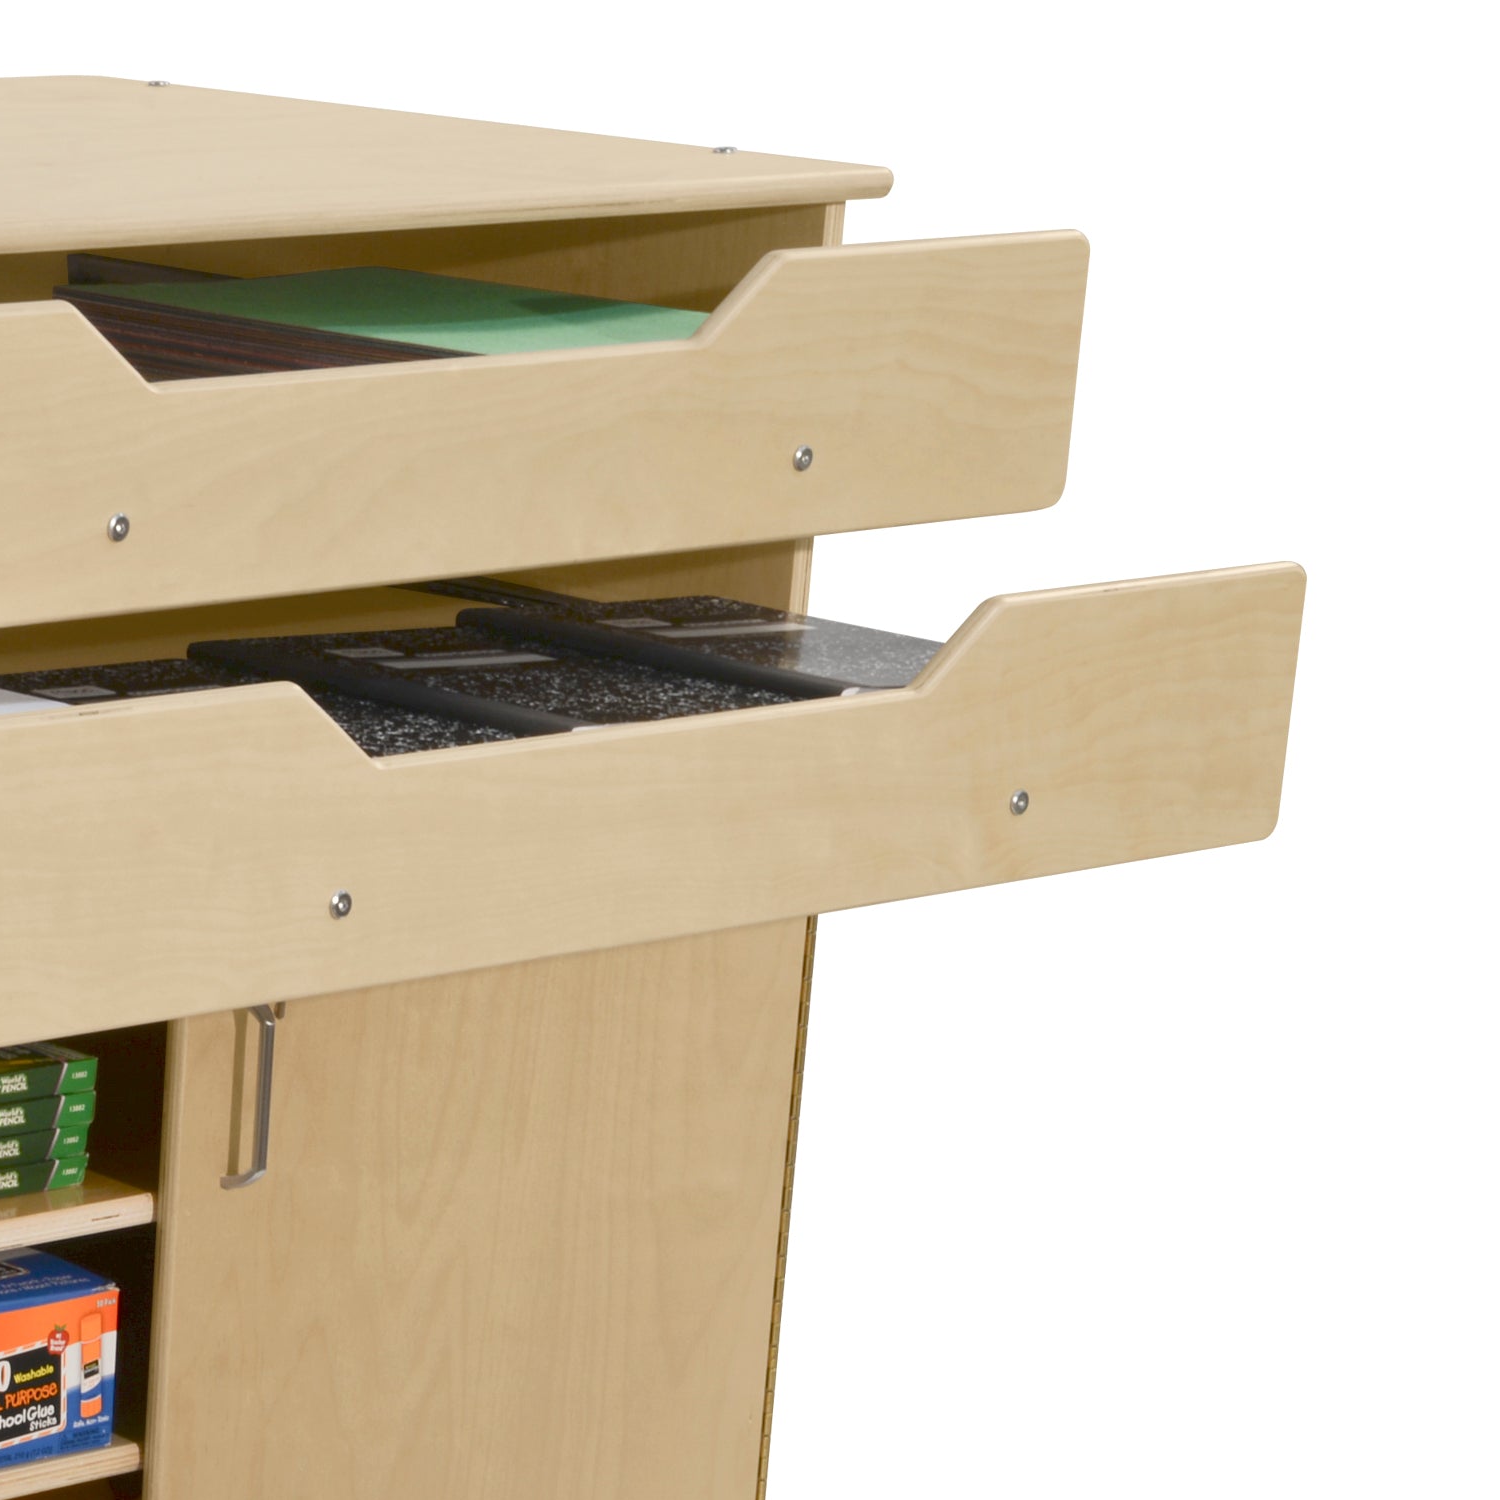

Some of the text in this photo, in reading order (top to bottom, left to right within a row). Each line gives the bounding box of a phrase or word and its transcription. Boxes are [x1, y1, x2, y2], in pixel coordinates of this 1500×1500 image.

[1, 1073, 27, 1084] World's
[1, 1082, 28, 1094] PENCIL
[0, 1116, 26, 1127] PENCIL
[13, 1364, 55, 1384] Washable
[29, 1415, 57, 1432] Sticks
